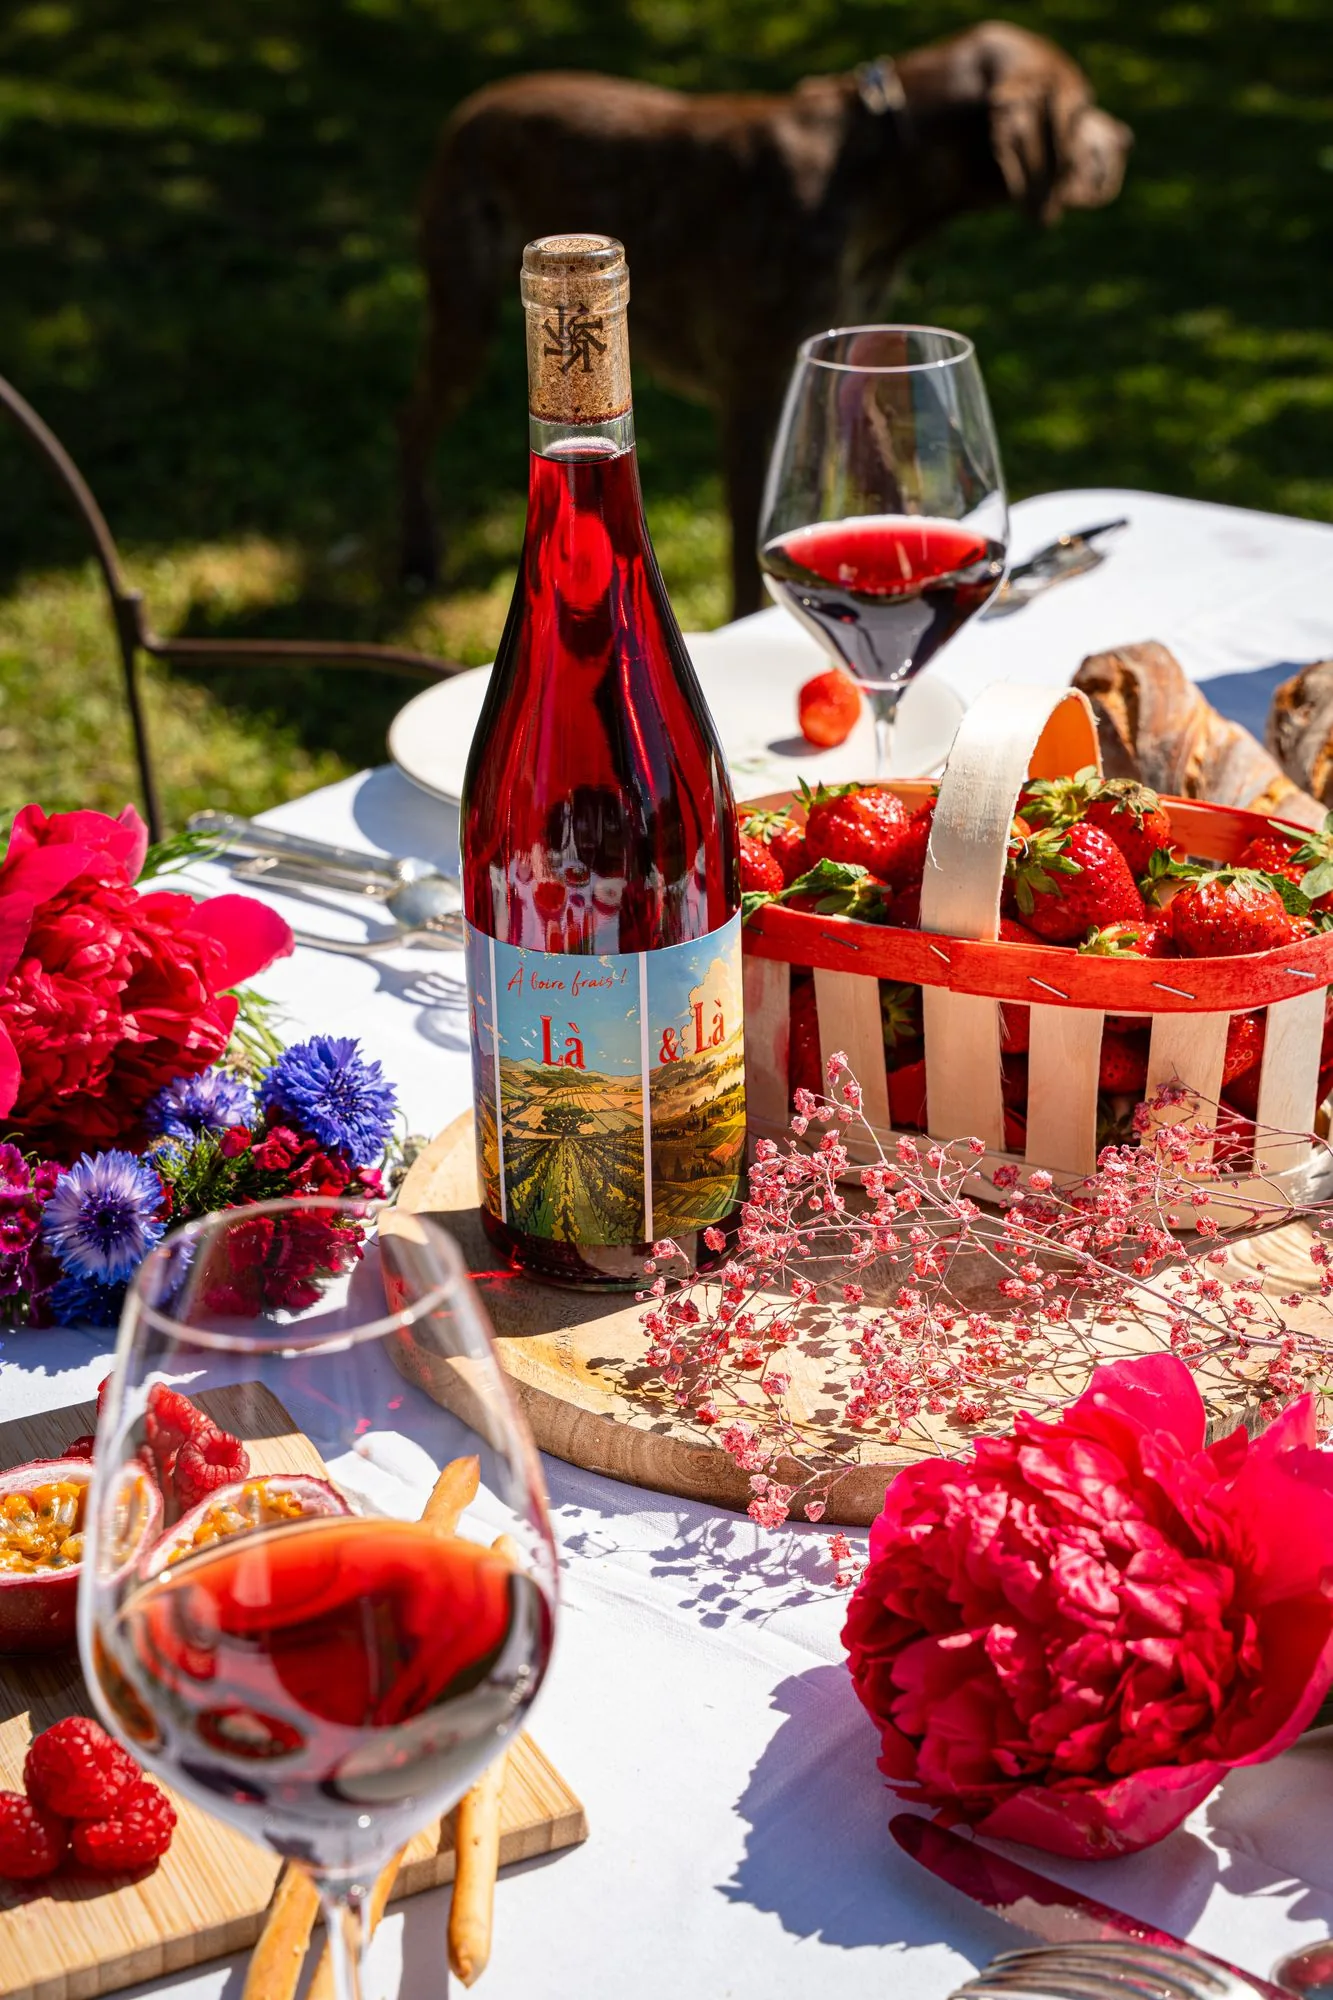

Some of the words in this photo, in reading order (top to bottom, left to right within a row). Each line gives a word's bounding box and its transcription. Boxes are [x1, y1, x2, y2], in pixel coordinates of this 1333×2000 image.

[507, 961, 524, 998] À
[530, 971, 566, 990] boire
[540, 1015, 586, 1070] Là
[659, 1027, 680, 1064] &
[694, 997, 725, 1054] Là
